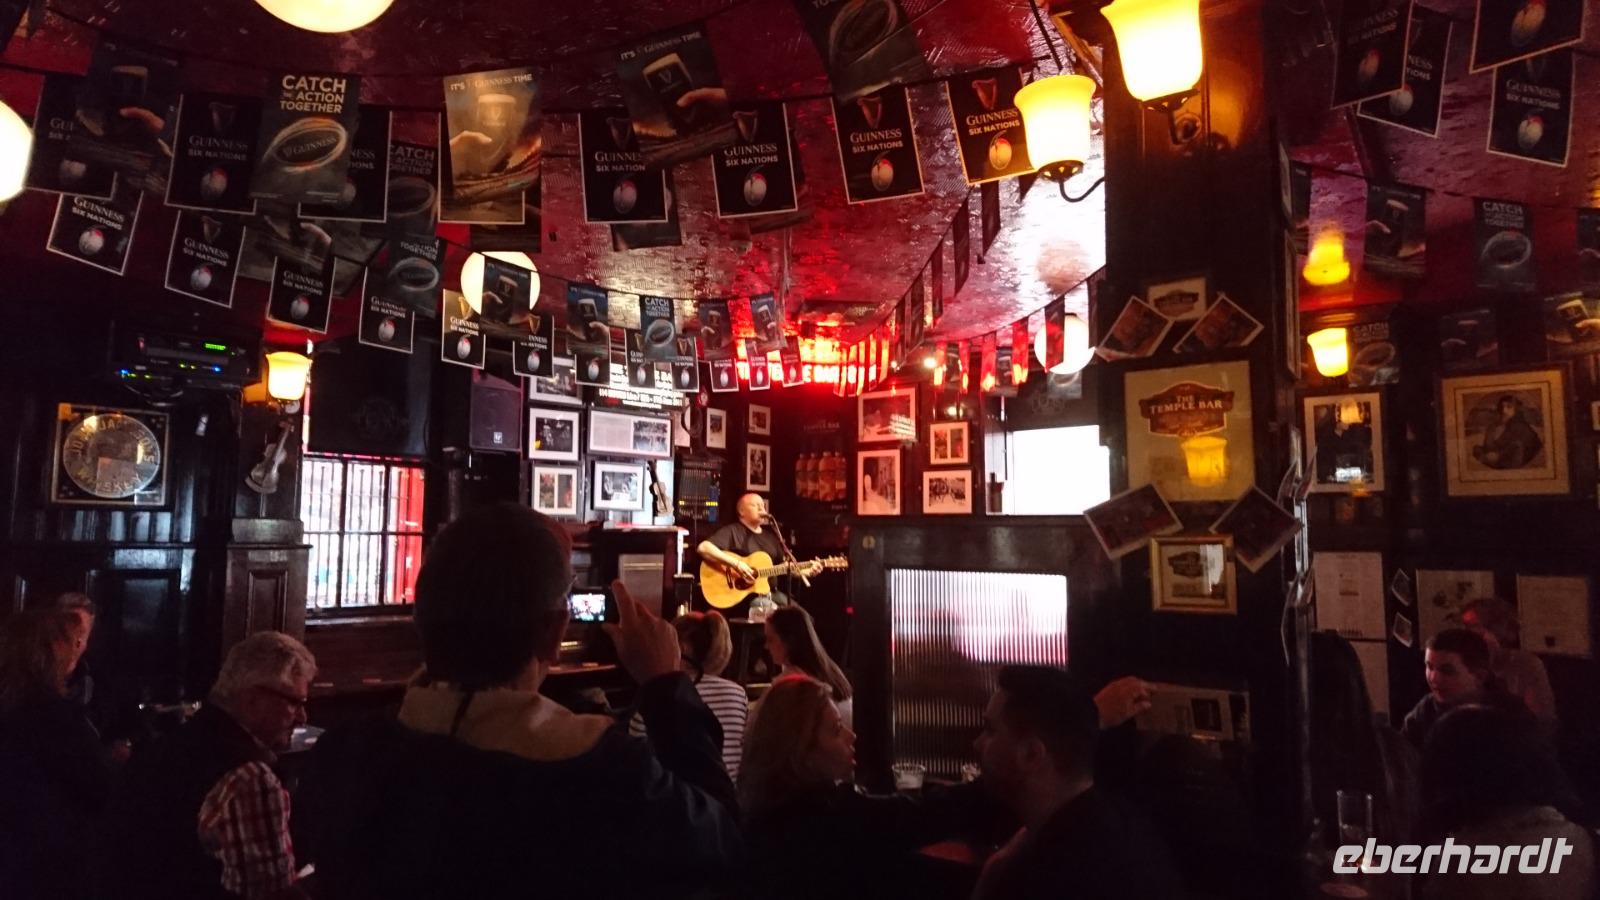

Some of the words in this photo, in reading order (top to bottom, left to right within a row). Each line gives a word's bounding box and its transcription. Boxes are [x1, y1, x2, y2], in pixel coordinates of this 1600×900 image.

[281, 74, 347, 94] CATCH
[513, 73, 533, 83] TIME
[1506, 79, 1560, 98] GUINNESS
[296, 92, 345, 105] ACTION
[1521, 97, 1560, 110] NATIONS
[280, 100, 343, 114] TOGETHER
[966, 109, 1018, 126] GUINNESS
[968, 126, 982, 137] SIX
[983, 119, 1020, 134] NATIONS
[850, 128, 902, 144] GUINNESS
[188, 135, 249, 153] GUINNESS
[724, 143, 778, 157] GUINNESS
[852, 143, 866, 154] SIX
[867, 140, 904, 153] NATIONS
[205, 150, 248, 162] NATIONS
[594, 150, 642, 163] GUINNE
[726, 158, 740, 168] SIX
[741, 154, 778, 165] NATIONS
[595, 164, 610, 173] SIX
[611, 163, 645, 172] NATION
[73, 196, 125, 223] GUINNESS
[1482, 201, 1524, 214] CATCH
[72, 206, 85, 217] SIX
[87, 211, 123, 231] NATIONS
[184, 237, 229, 260] GUINNESS
[183, 247, 195, 258] SIX
[196, 251, 228, 268] NATIONS
[283, 270, 324, 289] GUINNESS
[294, 283, 323, 296] NATIONS
[371, 295, 407, 312] GUINNESS
[381, 307, 406, 319] NATIONS
[450, 316, 480, 331] GUINNESS
[458, 325, 480, 337] NATIONS
[1150, 401, 1196, 414] TEMPLE
[1198, 399, 1223, 409] BAR
